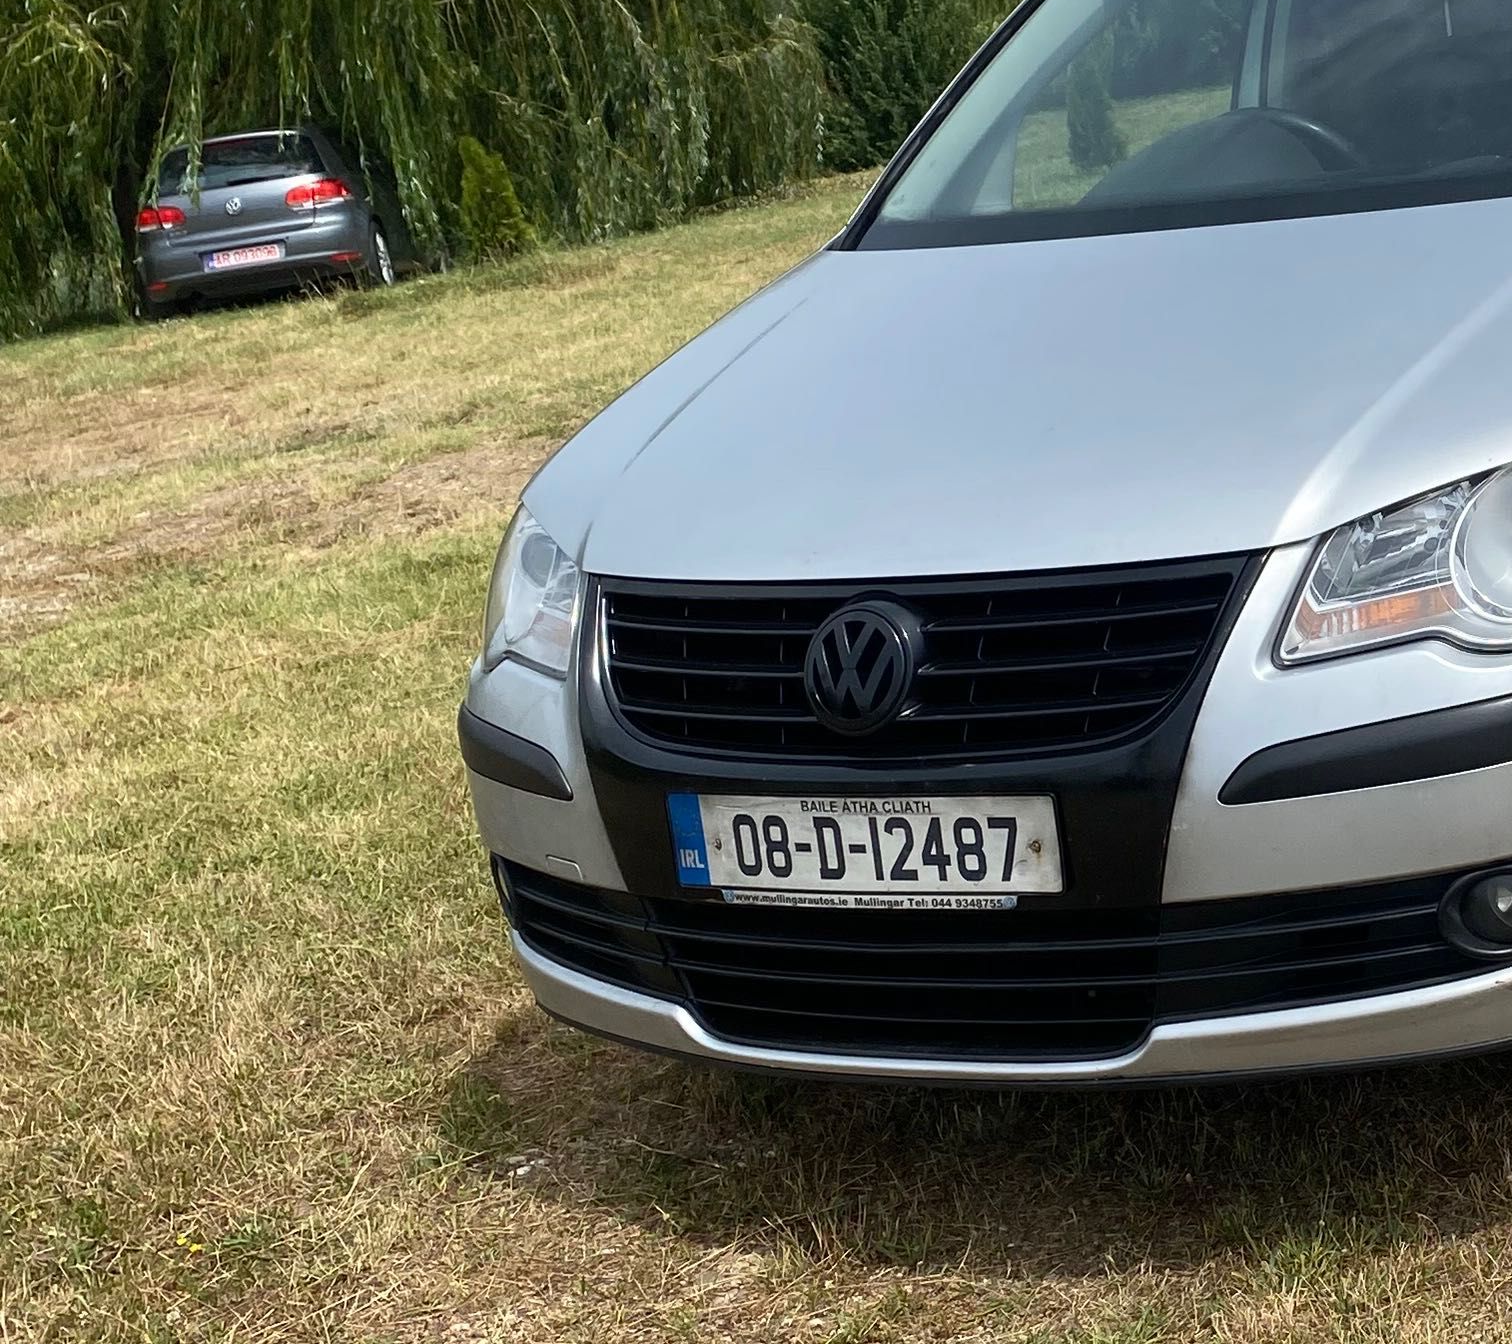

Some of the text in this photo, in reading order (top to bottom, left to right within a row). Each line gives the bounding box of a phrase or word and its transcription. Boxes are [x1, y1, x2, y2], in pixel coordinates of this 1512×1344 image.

[800, 797, 932, 814] BAILE ÁTHA CLIATH
[732, 813, 1018, 882] 08-D-12487
[679, 848, 705, 869] IRL
[734, 893, 1003, 909] www.mullingarautos.ie Mullingar Tel: 044 9348755
